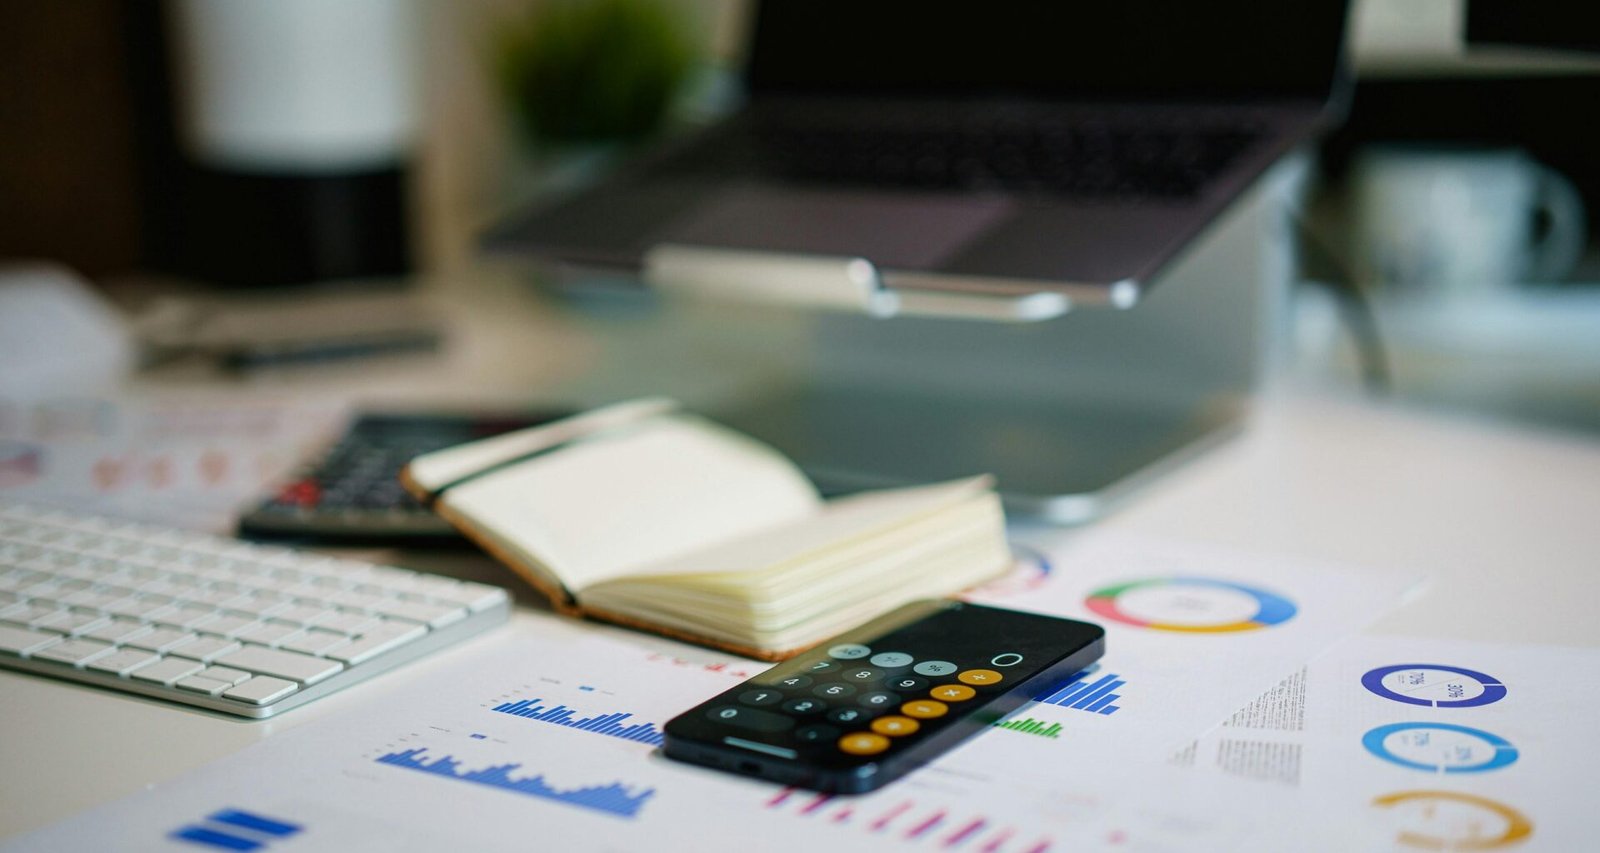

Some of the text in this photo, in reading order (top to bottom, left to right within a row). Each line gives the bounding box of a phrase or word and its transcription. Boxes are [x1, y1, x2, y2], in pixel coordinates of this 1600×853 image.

[991, 653, 1023, 667] 0
[813, 662, 829, 670] 7
[856, 671, 871, 679] 8
[900, 680, 915, 688] 9
[784, 677, 887, 704] 4 5 6
[1447, 684, 1464, 698] 30%
[719, 708, 738, 719] 0
[755, 693, 858, 721] 1 2 3
